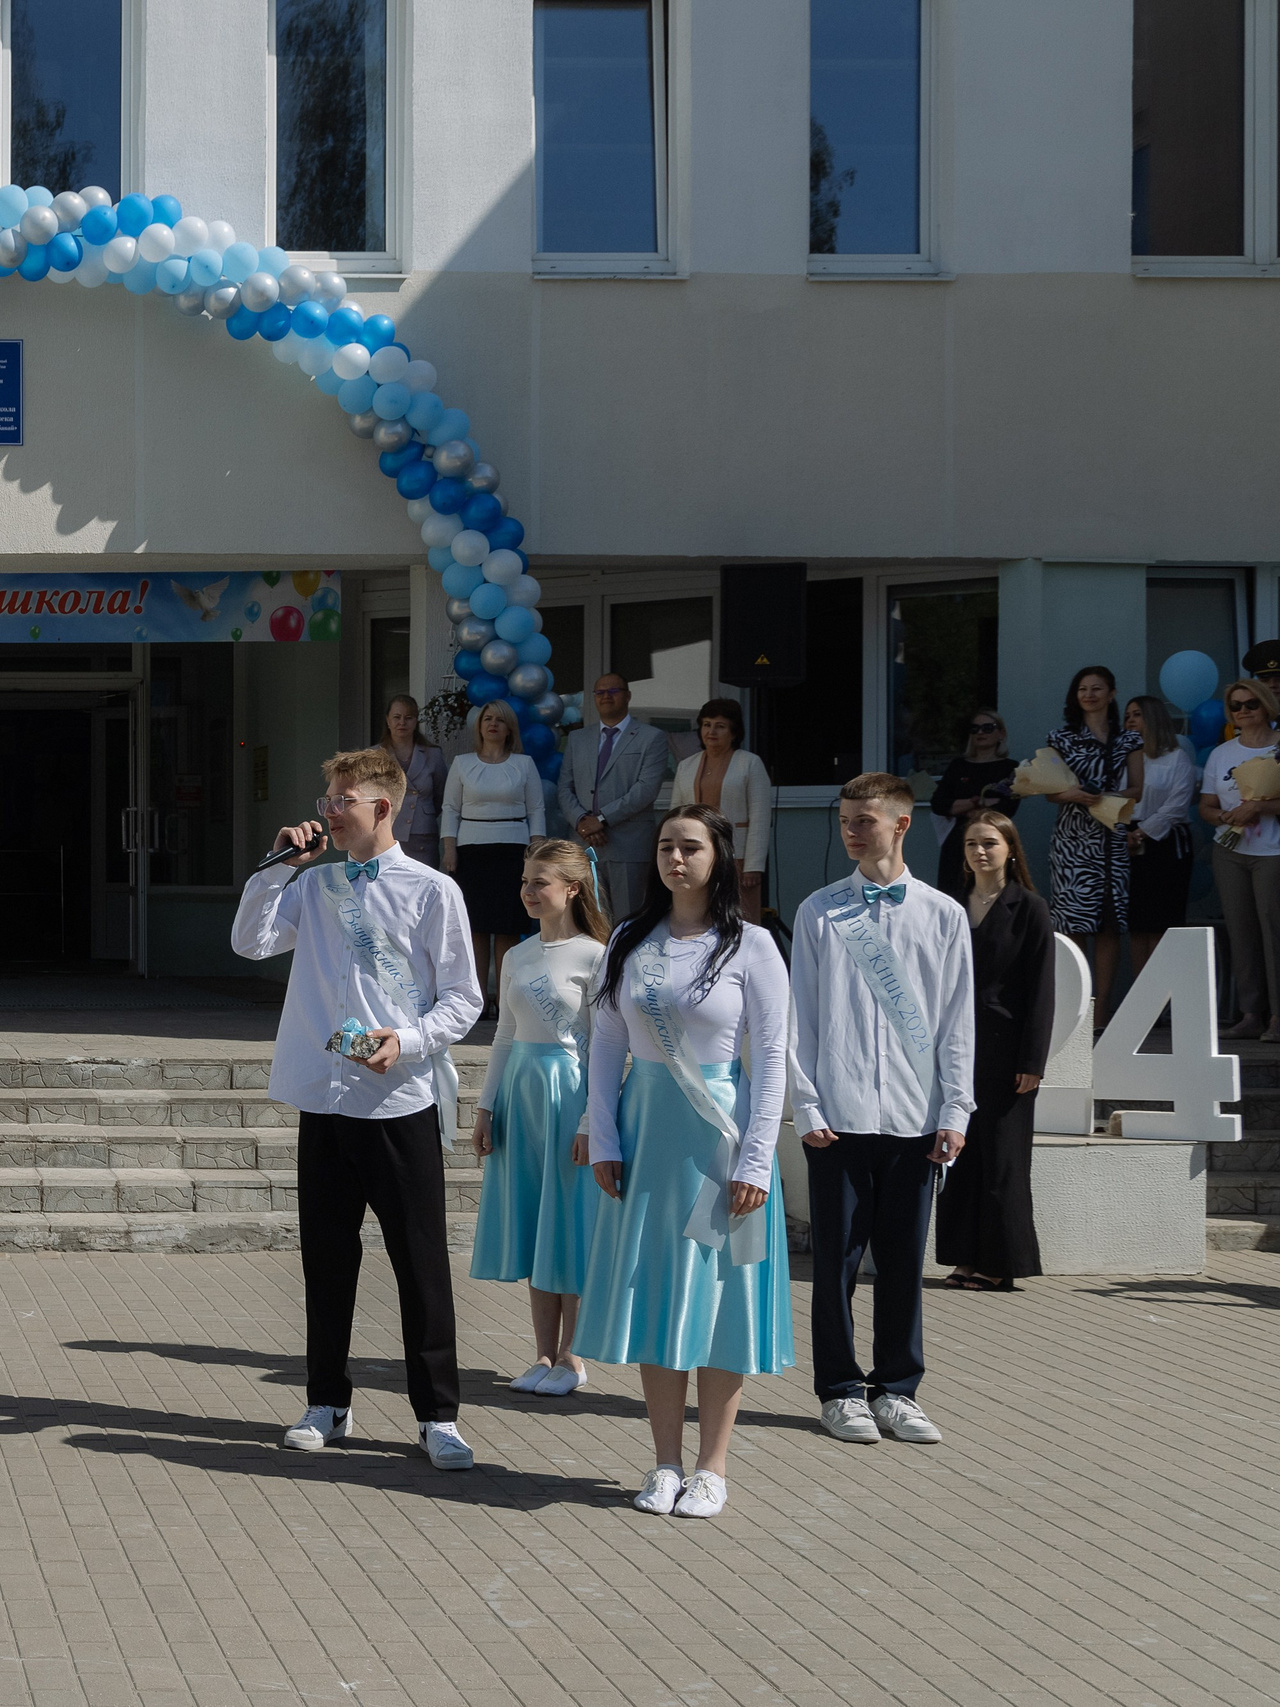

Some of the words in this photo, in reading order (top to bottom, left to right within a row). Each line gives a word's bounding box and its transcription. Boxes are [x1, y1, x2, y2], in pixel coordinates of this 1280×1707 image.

[337, 896, 404, 984] Выпускник
[398, 980, 429, 1011] 202
[829, 885, 908, 1007] Выпускник
[898, 1003, 931, 1054] 2024
